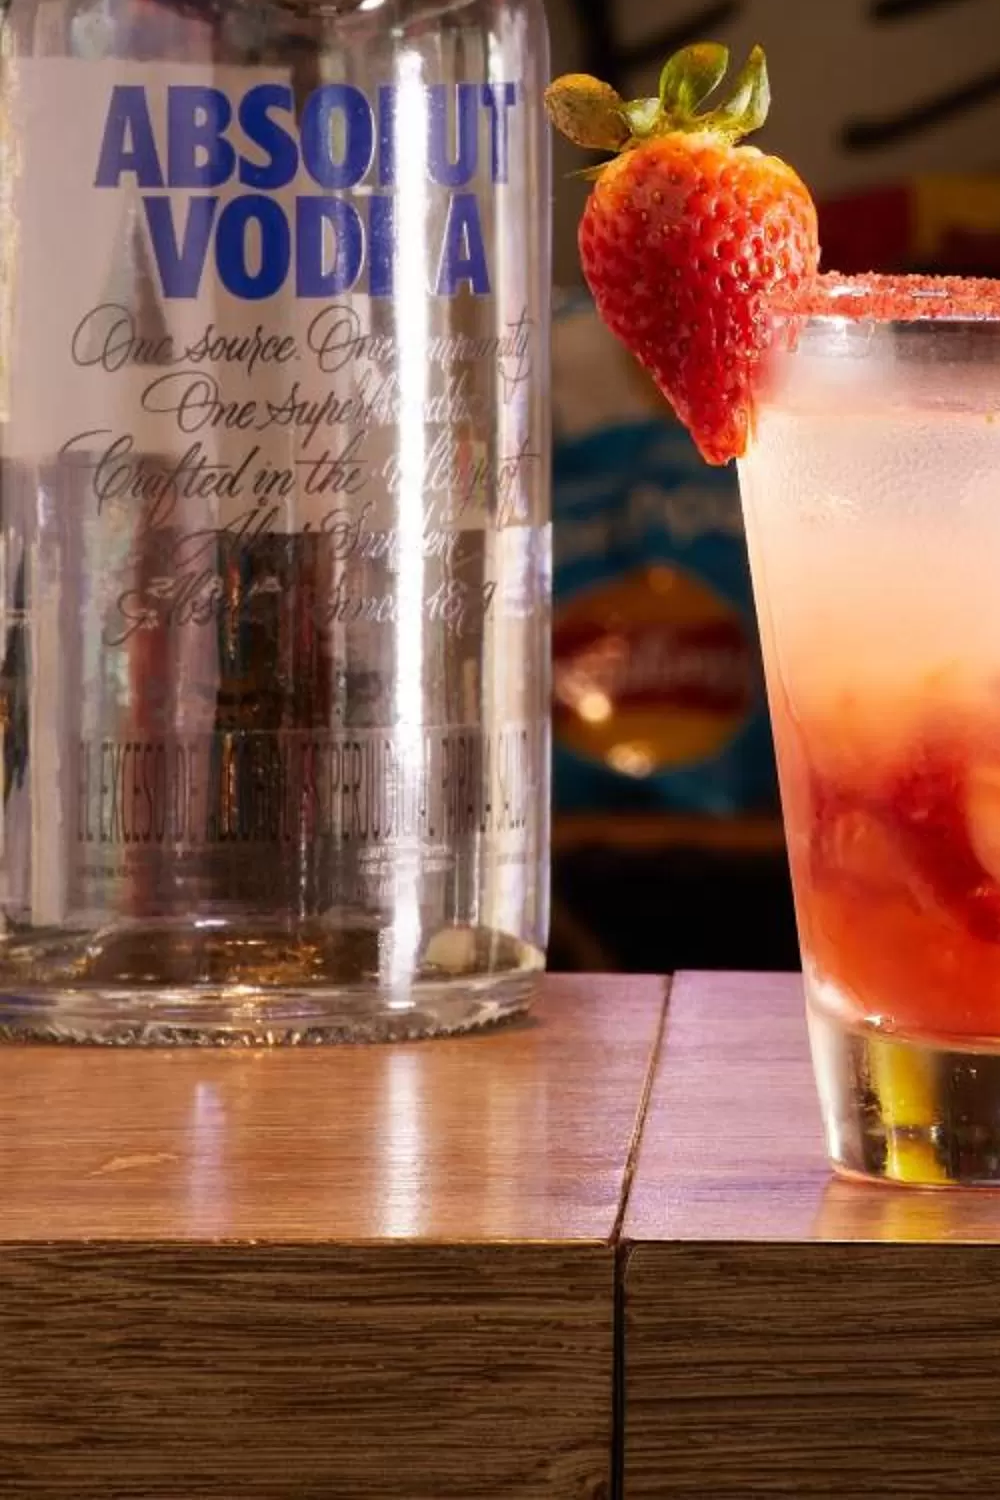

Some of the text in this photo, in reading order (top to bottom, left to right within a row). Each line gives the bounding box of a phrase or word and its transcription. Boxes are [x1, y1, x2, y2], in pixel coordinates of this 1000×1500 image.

[72, 303, 176, 373] One
[141, 369, 256, 432] One
[62, 429, 260, 522] Crafted
[252, 460, 297, 498] in
[294, 428, 368, 496] the
